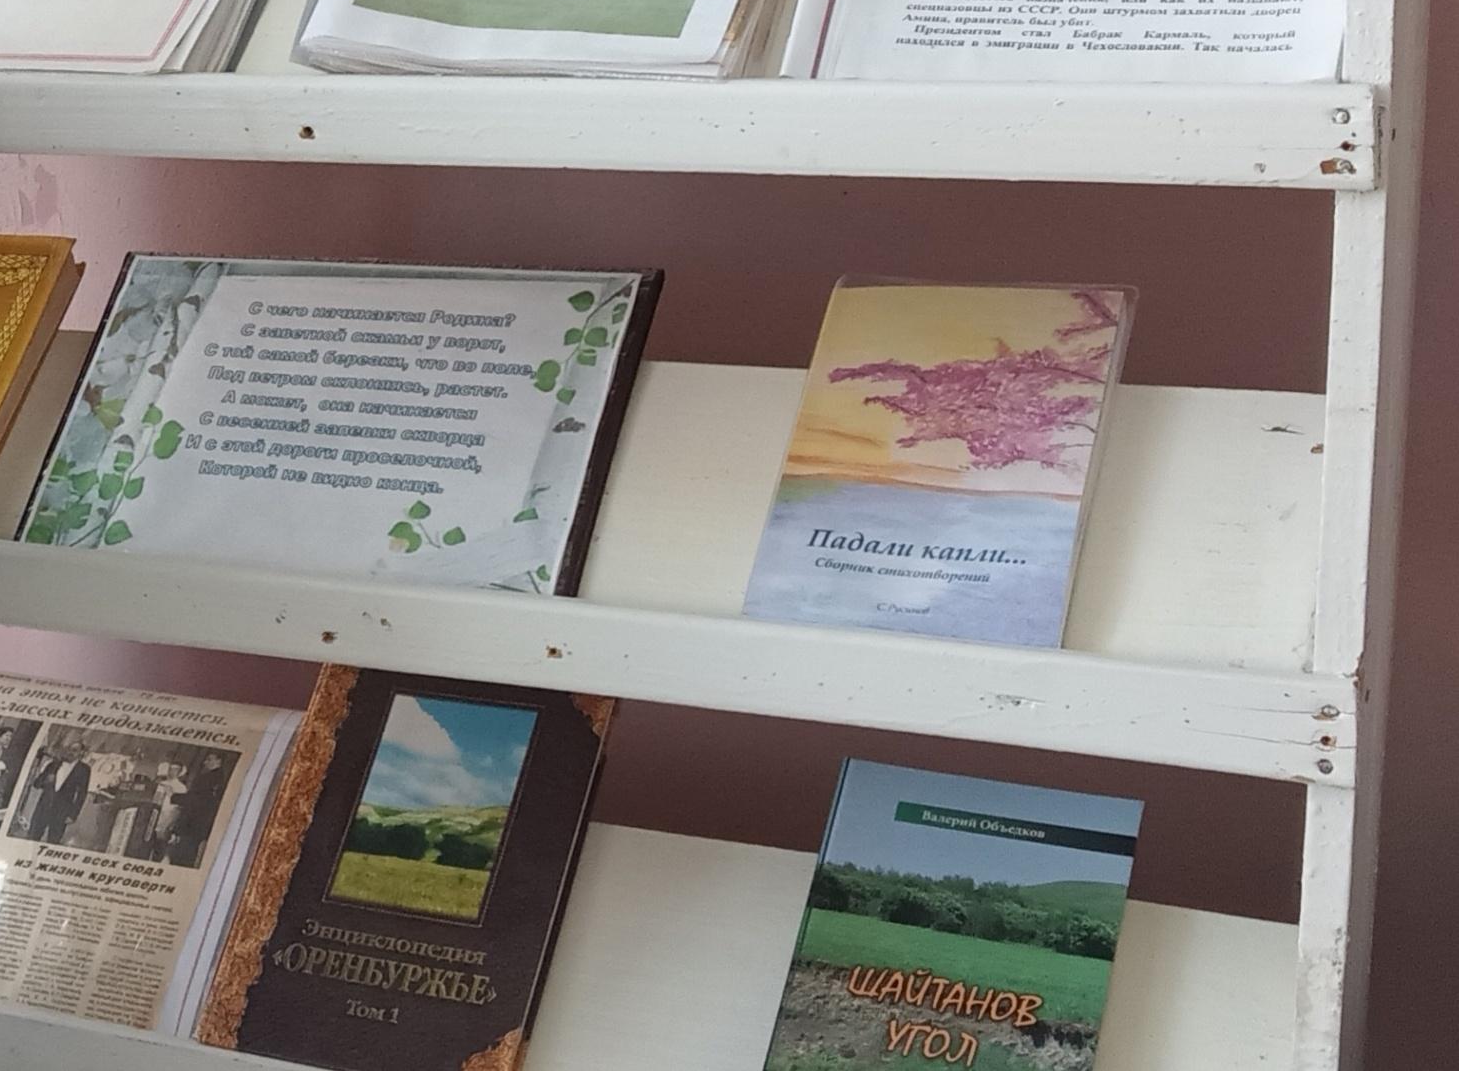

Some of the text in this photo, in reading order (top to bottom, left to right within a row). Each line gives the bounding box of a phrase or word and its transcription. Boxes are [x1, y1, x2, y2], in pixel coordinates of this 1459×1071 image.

[248, 302, 517, 327] С чего начинается Родина?
[240, 323, 506, 353] С заветной скамьи у ворот,
[204, 343, 220, 357] С
[223, 344, 254, 360] той
[258, 348, 319, 363] самой
[416, 356, 448, 371] что
[453, 359, 477, 373] во
[481, 360, 536, 379] поле,
[208, 365, 244, 383] Под
[248, 371, 317, 387] ветром
[435, 382, 508, 400] растет.
[222, 390, 478, 420] А может, она начинается
[199, 411, 214, 425] С
[217, 413, 311, 432] весенней
[401, 428, 485, 447] скворца
[186, 434, 483, 474] И с этой дороги проселочной,
[199, 460, 444, 494] Которой не видно конца.
[806, 528, 1028, 565] Падали капли...
[814, 557, 991, 584] Сборник стихотворений
[19, 684, 79, 708] этом
[84, 694, 107, 712] не
[110, 696, 229, 726] кончается.
[77, 708, 242, 747] продолжается.
[922, 809, 978, 830] Валерий
[14, 855, 176, 895] из жизни круговерти
[37, 845, 163, 878] Тянет всех сюда
[302, 918, 488, 966] Энциклопедия
[272, 941, 497, 1005] «ОРЕНБУРЖЬЕ»
[346, 999, 400, 1024] Том 1
[847, 965, 1043, 1027] ШАЙТАНОВ
[887, 1019, 979, 1066] УГОЛ
